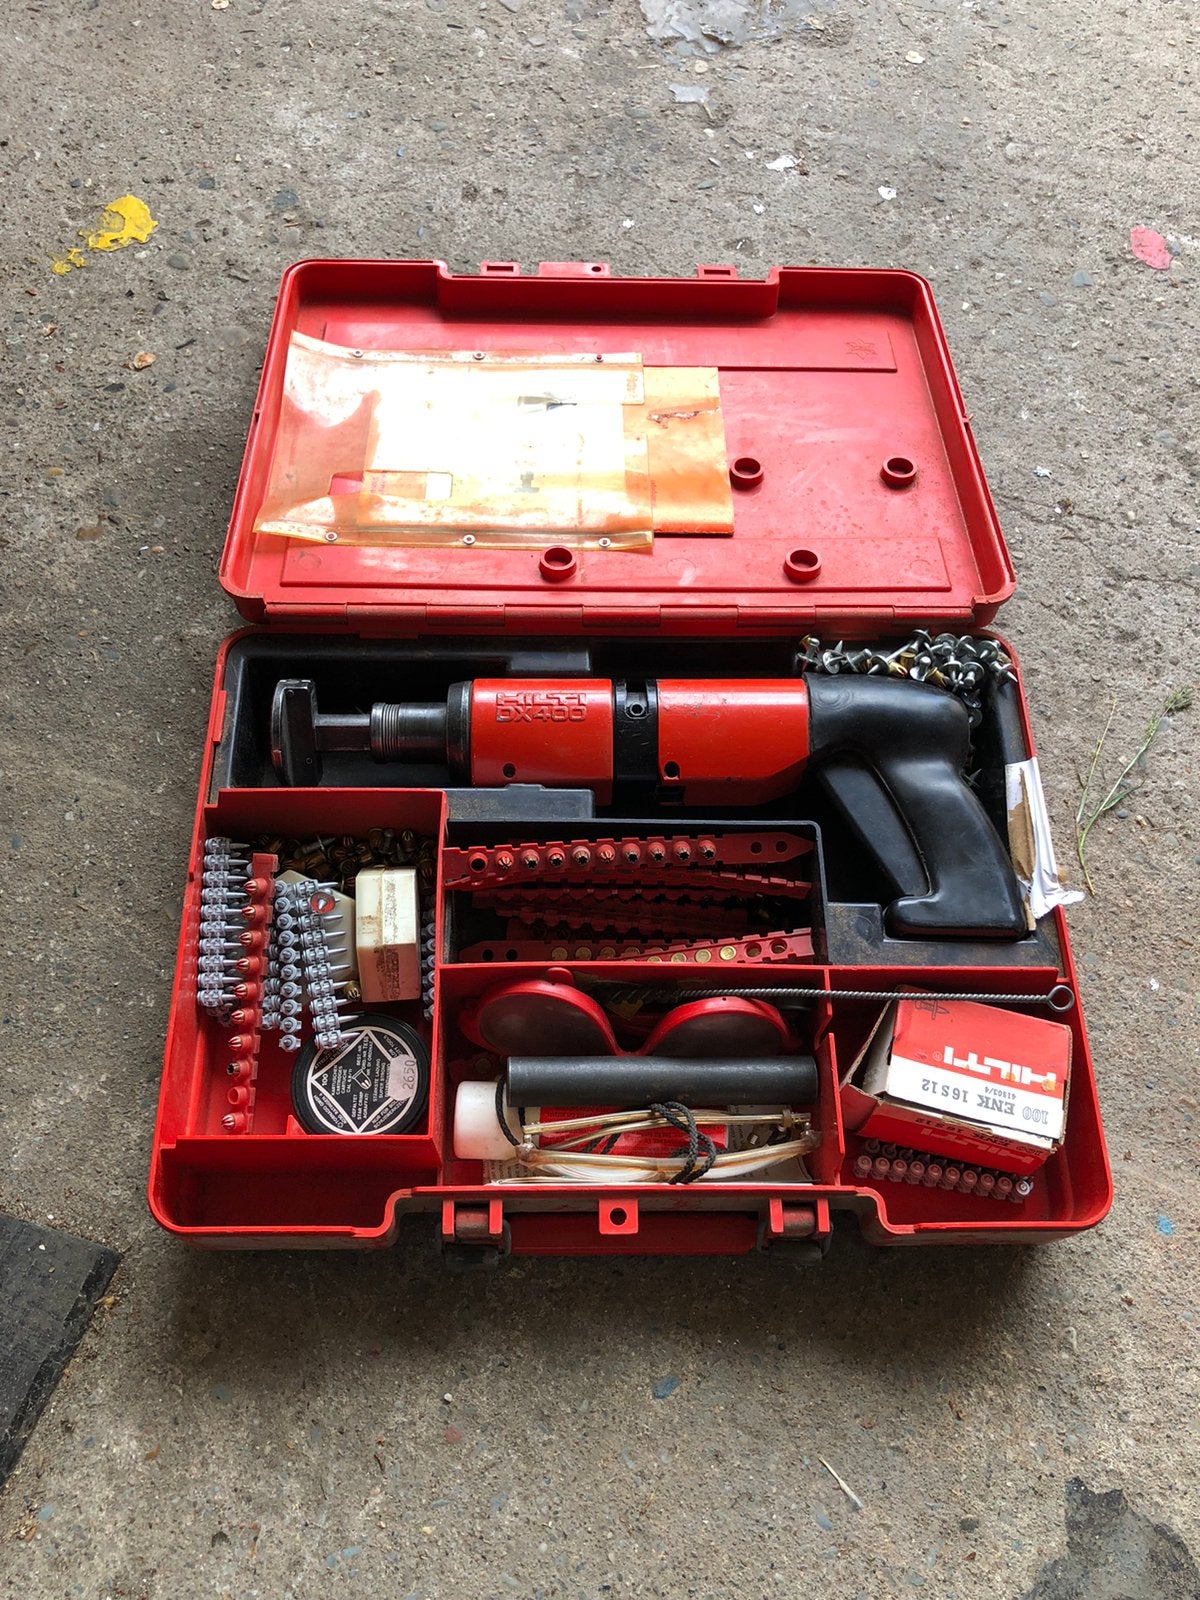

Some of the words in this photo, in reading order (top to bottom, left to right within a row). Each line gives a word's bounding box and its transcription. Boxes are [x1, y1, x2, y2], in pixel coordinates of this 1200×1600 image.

[496, 692, 587, 706] HILTI
[943, 1046, 1056, 1092] HILTI
[984, 1086, 1016, 1100] 41503/4
[976, 1094, 1016, 1116] ENK
[1022, 1106, 1048, 1124] 100
